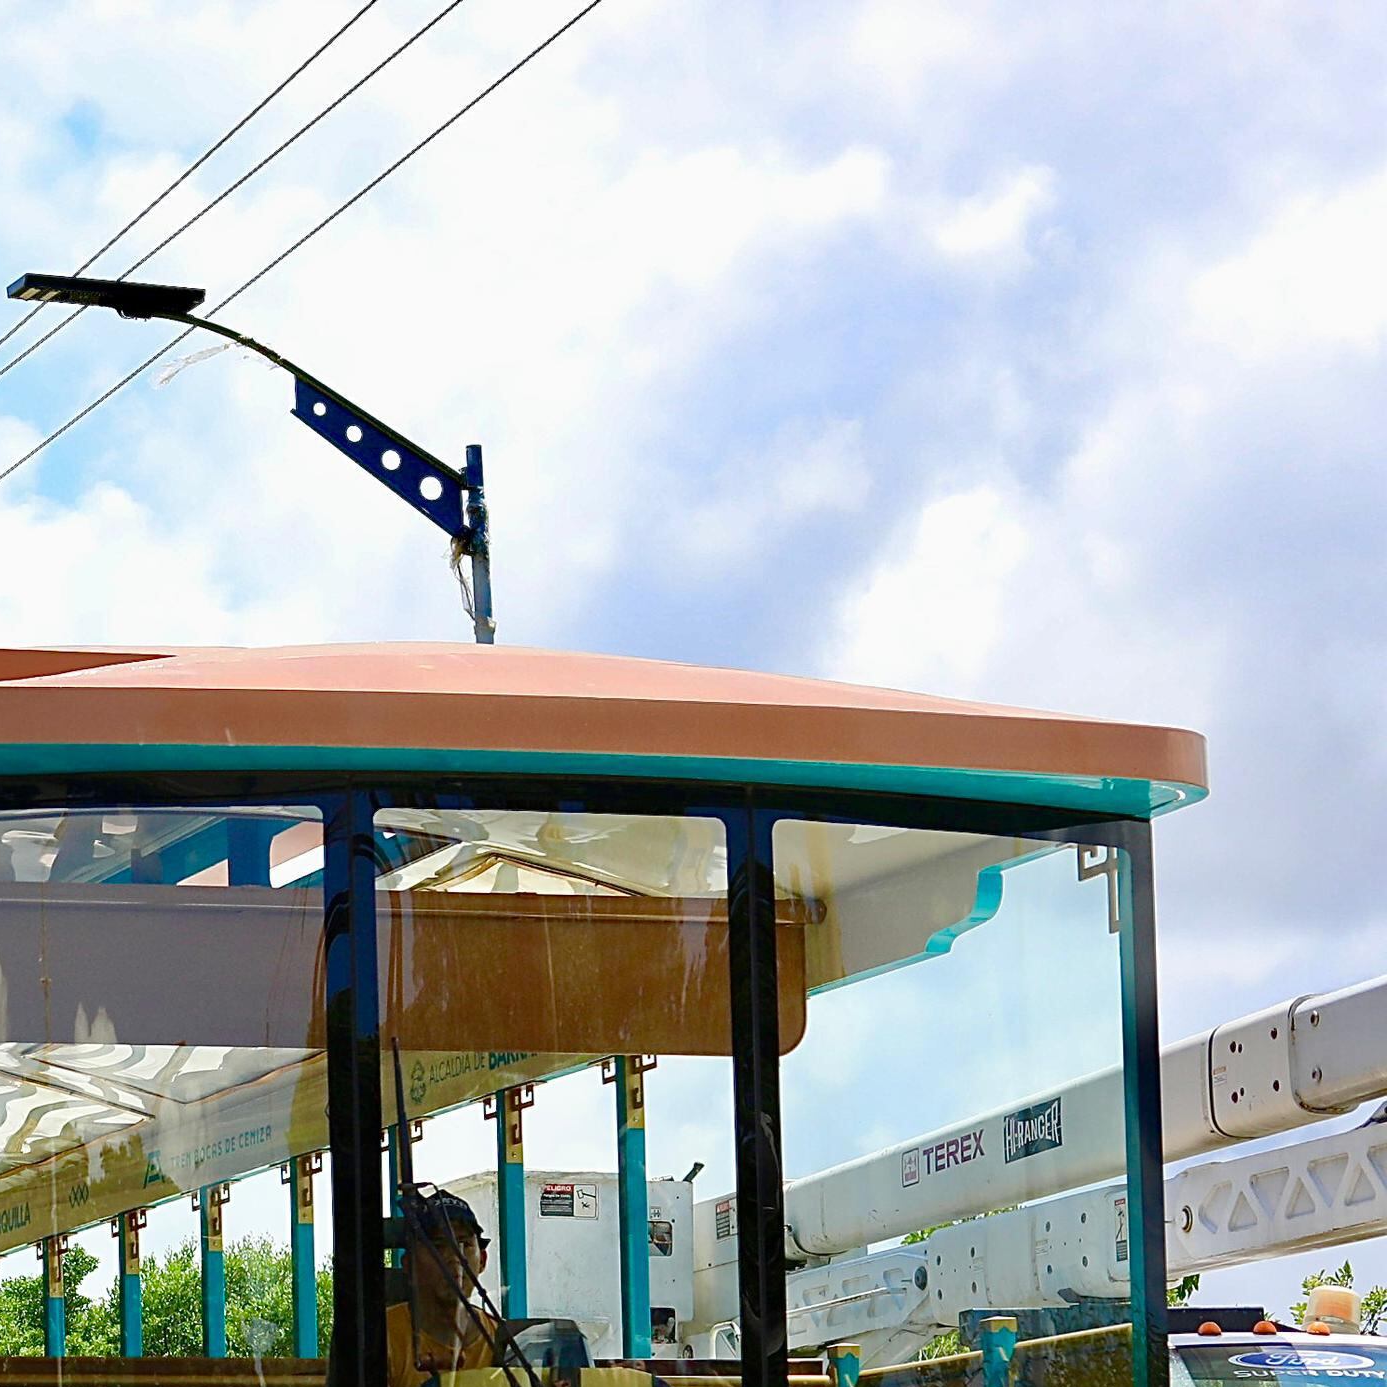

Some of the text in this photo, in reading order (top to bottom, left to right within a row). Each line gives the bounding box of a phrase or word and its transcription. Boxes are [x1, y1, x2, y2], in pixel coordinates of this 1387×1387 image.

[225, 1137, 236, 1154] DE
[922, 1128, 986, 1175] TEREX
[1265, 1352, 1341, 1366] Ford
[1233, 1369, 1387, 1379] SUPER DUTY
